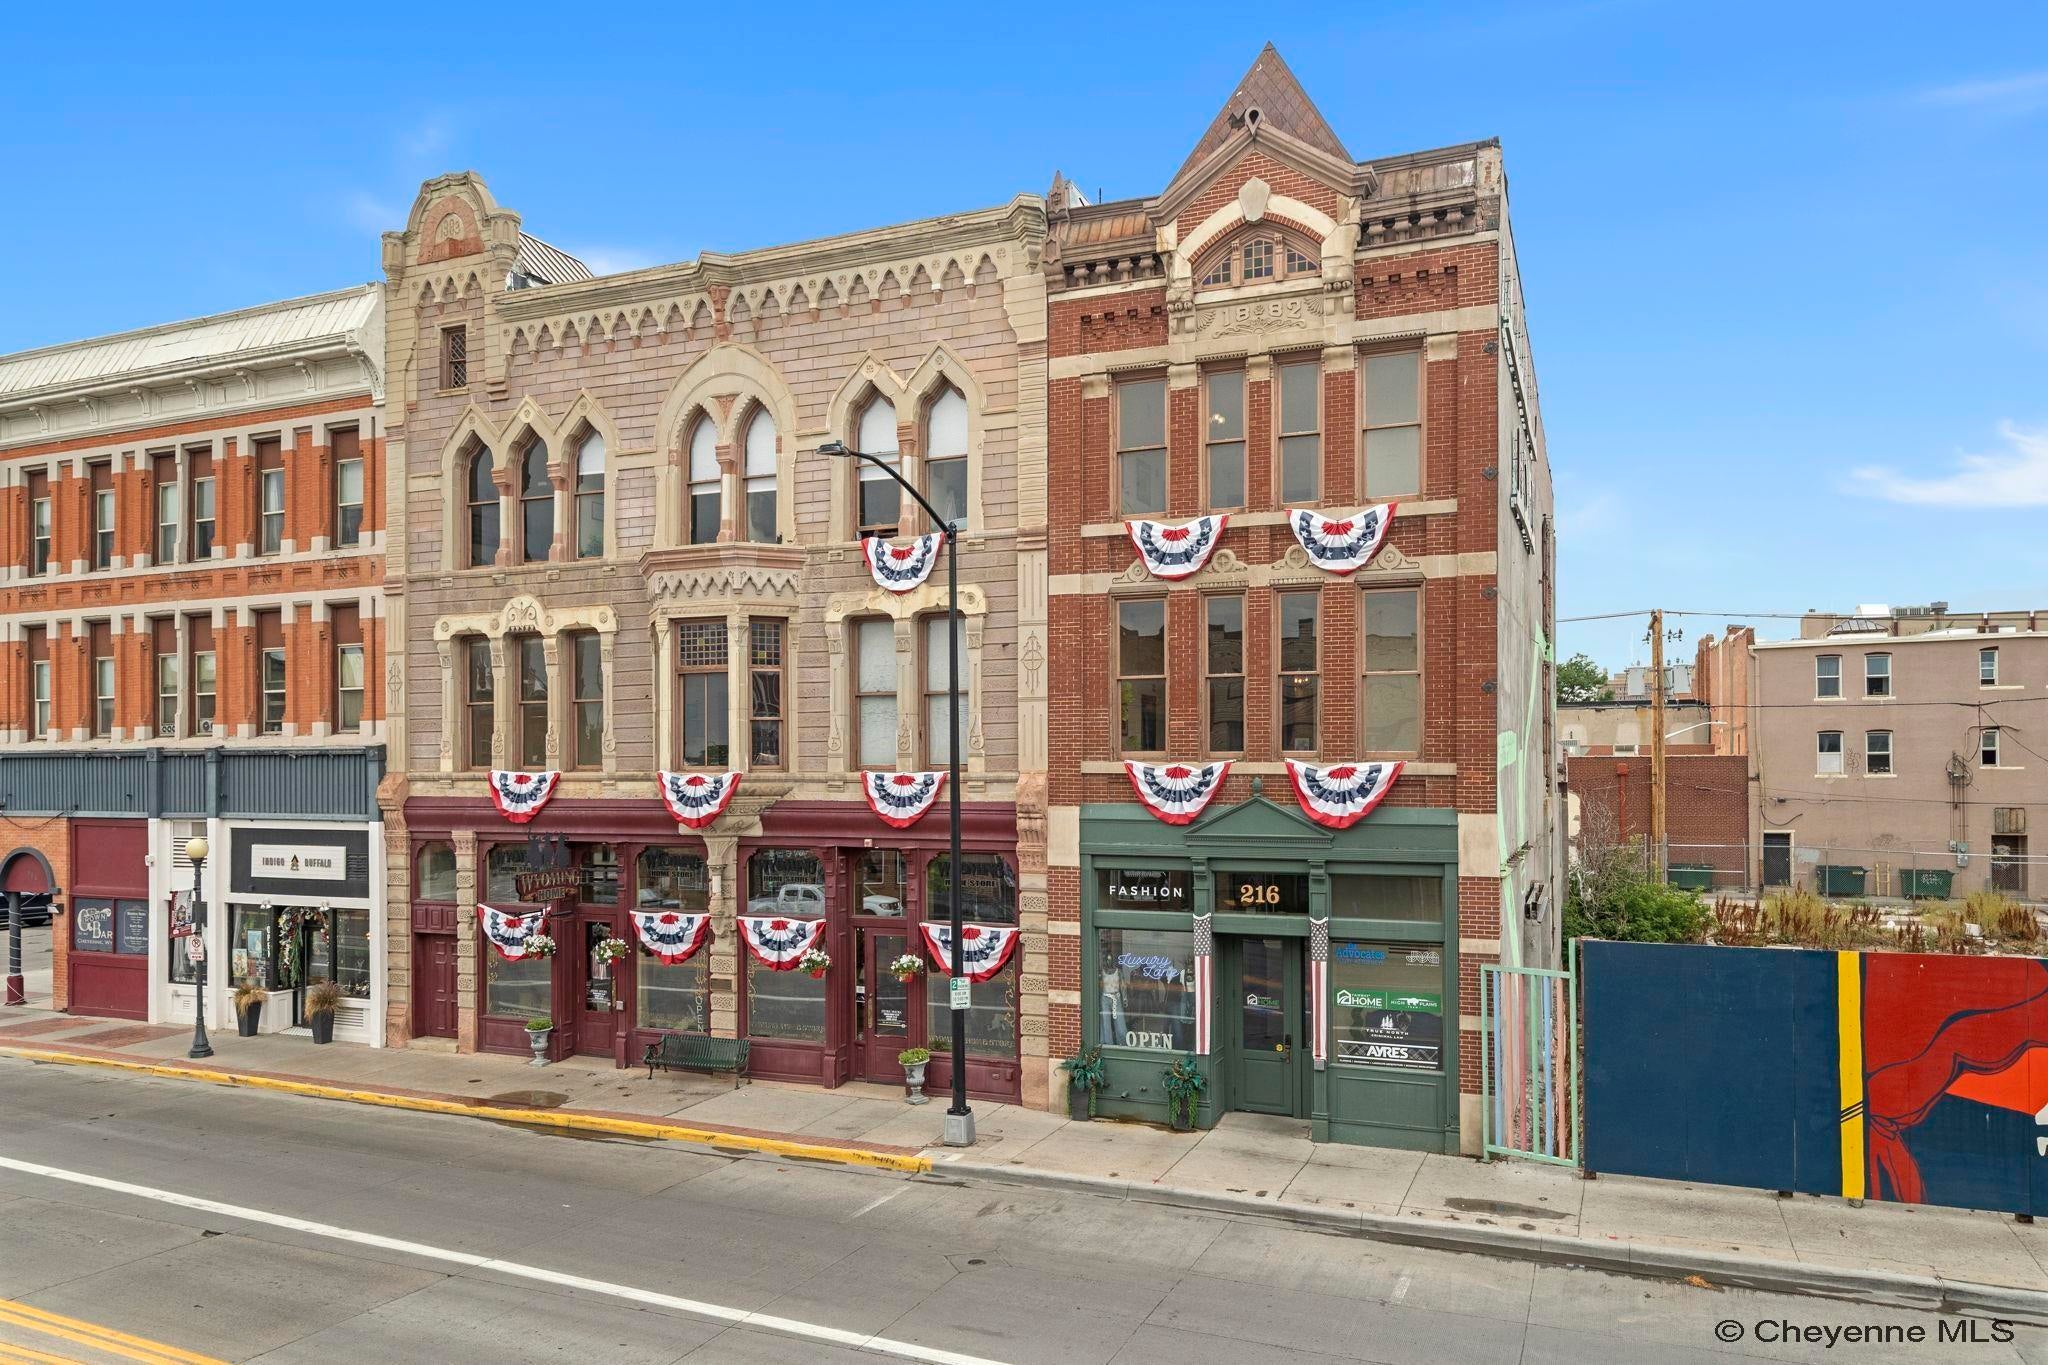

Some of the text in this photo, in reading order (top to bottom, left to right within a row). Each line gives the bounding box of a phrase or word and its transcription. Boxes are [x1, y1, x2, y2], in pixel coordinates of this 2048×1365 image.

[262, 857, 285, 866] INDIGO
[304, 858, 332, 868] BUFFALO
[521, 868, 581, 894] WYOMING
[537, 886, 567, 901] HOME
[1109, 885, 1183, 898] FASHION
[1240, 884, 1280, 904] 216
[92, 920, 113, 939] BAR
[1117, 952, 1172, 969] Luxury
[1142, 964, 1181, 980] Lane
[1351, 997, 1383, 1007] HOME
[695, 996, 704, 1034] OPEN
[1125, 1030, 1174, 1050] OPEN
[1366, 1045, 1409, 1060] AYRES
